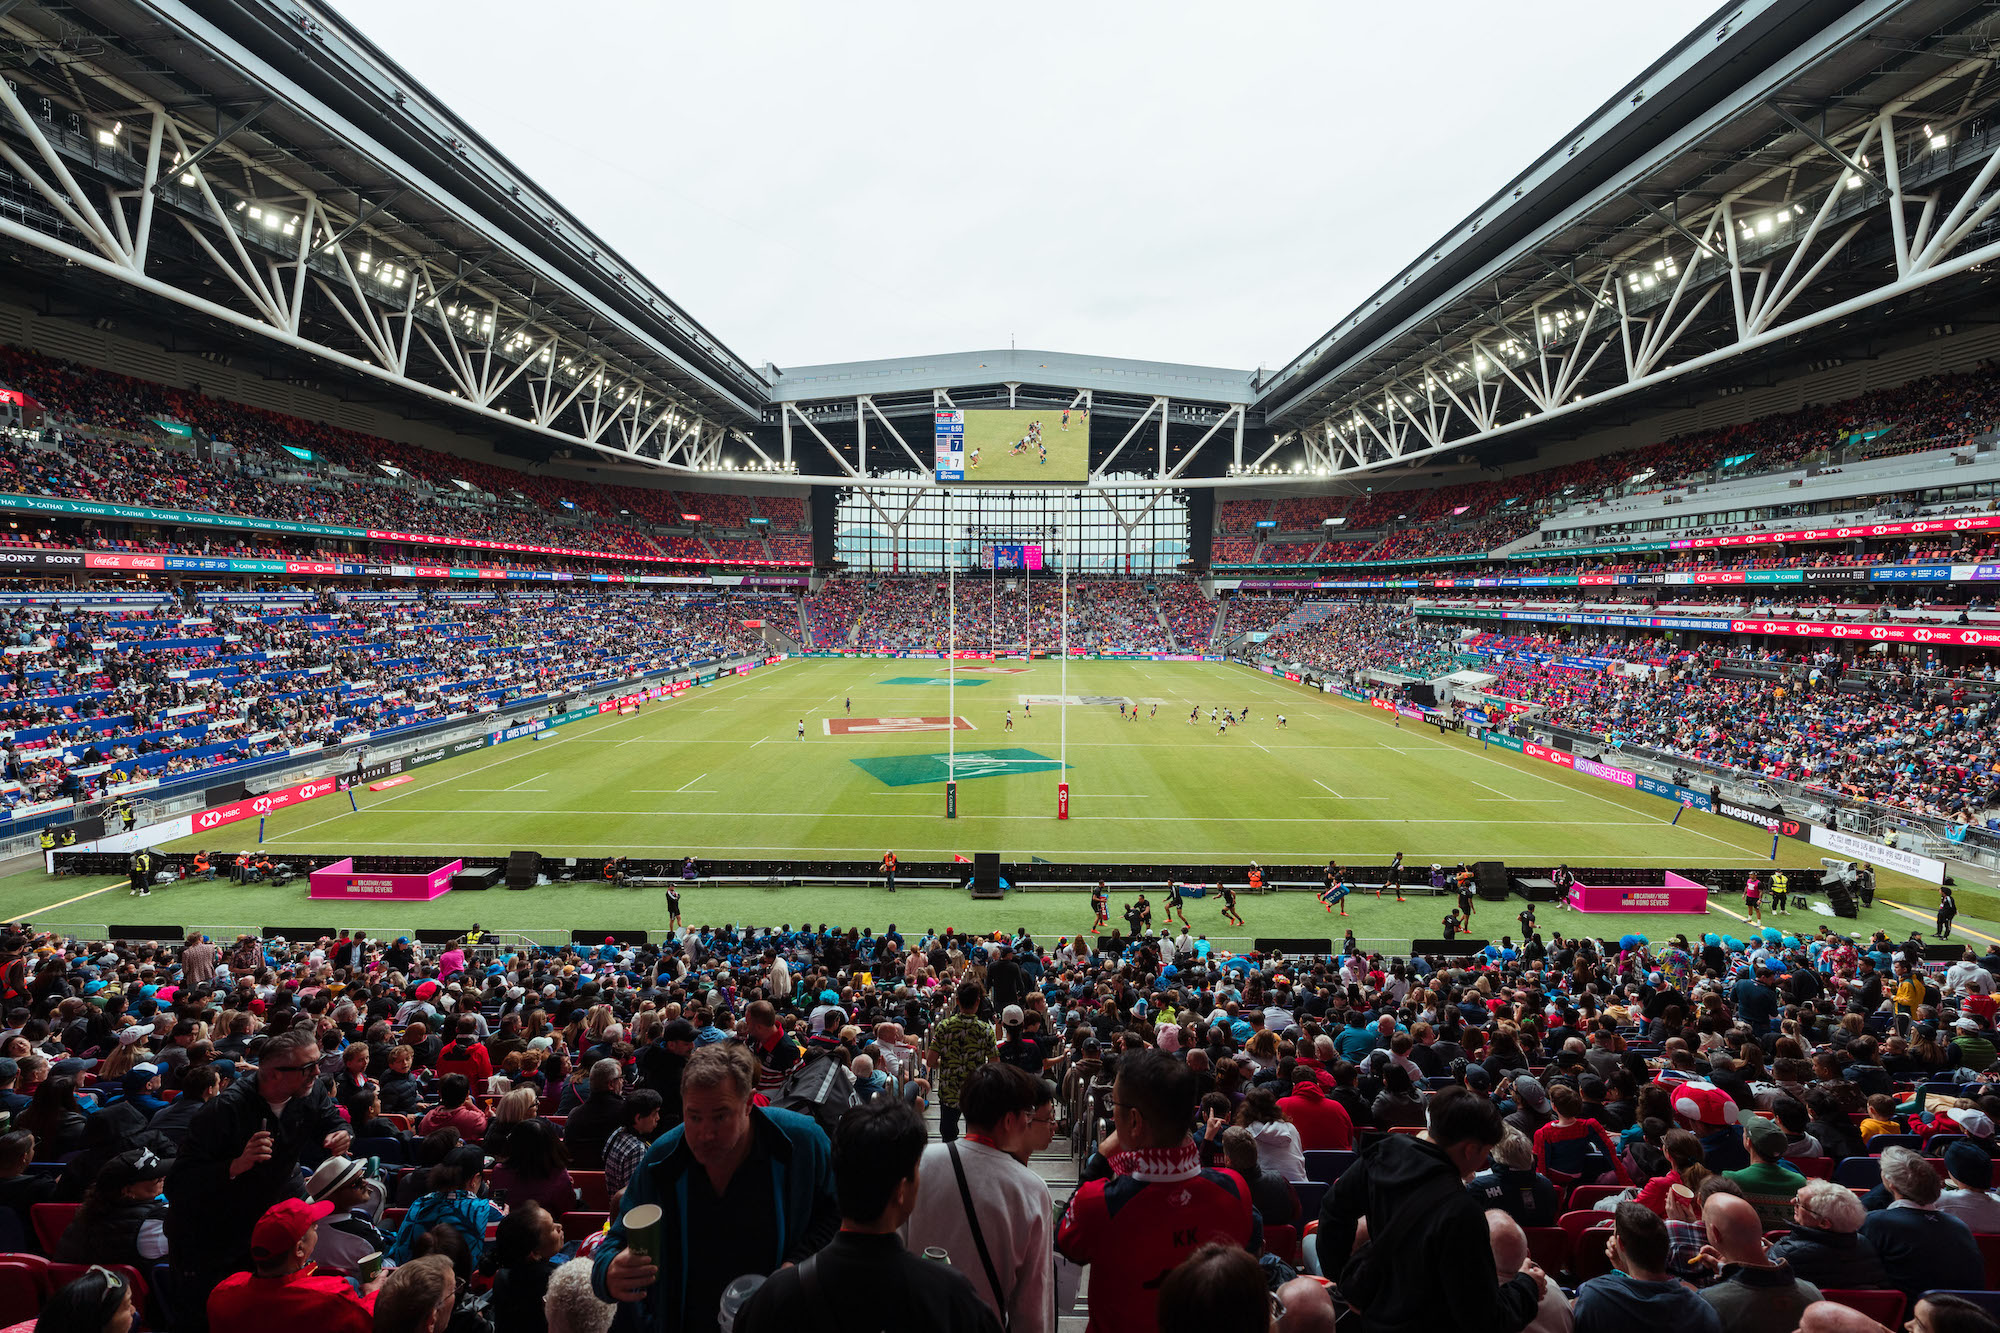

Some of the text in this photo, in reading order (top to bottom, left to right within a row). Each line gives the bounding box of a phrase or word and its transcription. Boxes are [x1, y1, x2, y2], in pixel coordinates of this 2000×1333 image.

[954, 441, 960, 450] 7
[955, 459, 959, 468] 7
[36, 502, 64, 510] CATHAY
[80, 506, 105, 514] CATHAY
[0, 554, 37, 563] SONY
[45, 555, 81, 564] SONY
[344, 566, 353, 574] USA
[506, 728, 519, 739] GIVES
[520, 725, 529, 735] YOU
[1506, 740, 1521, 749] CATHAY
[1575, 758, 1633, 785] @SVNSSERIES
[317, 783, 332, 792] HSBC
[272, 795, 289, 804] HSBC
[222, 808, 241, 819] HSBC
[1720, 803, 1798, 835] RUGBYPASS TV
[1828, 841, 1920, 874] Major Sports Events Committee
[1485, 1185, 1503, 1199] HH
[1173, 1226, 1199, 1249] KK
